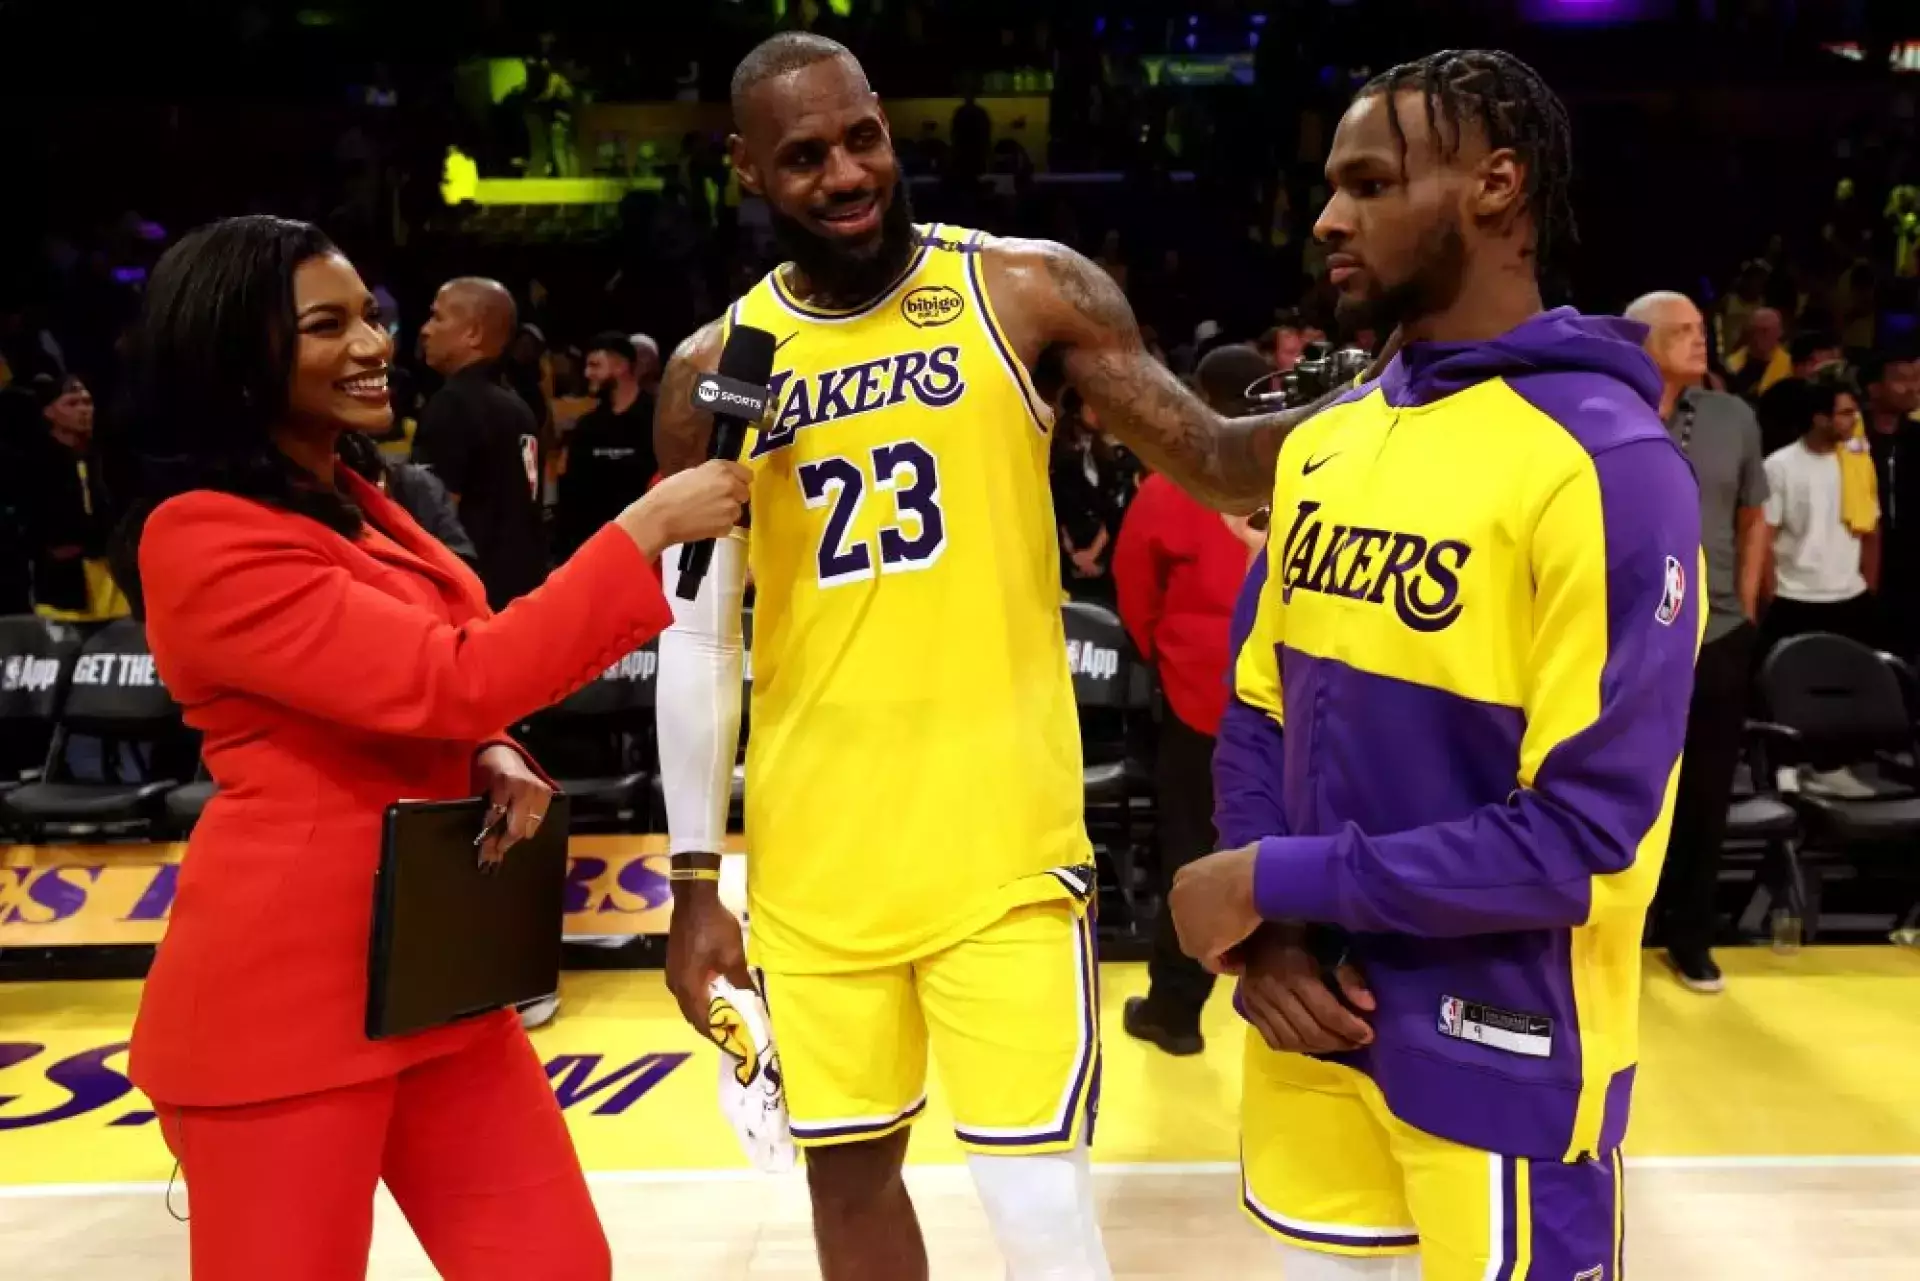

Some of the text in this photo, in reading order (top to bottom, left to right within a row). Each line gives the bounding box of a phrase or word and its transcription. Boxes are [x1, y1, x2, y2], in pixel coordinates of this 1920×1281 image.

[907, 296, 959, 313] bibigo
[721, 391, 762, 409] SPORTS
[749, 346, 966, 460] LAKERS
[797, 439, 948, 588] 23
[1283, 500, 1473, 633] LAKERS
[72, 653, 156, 686] GET THE
[1081, 640, 1119, 680] App
